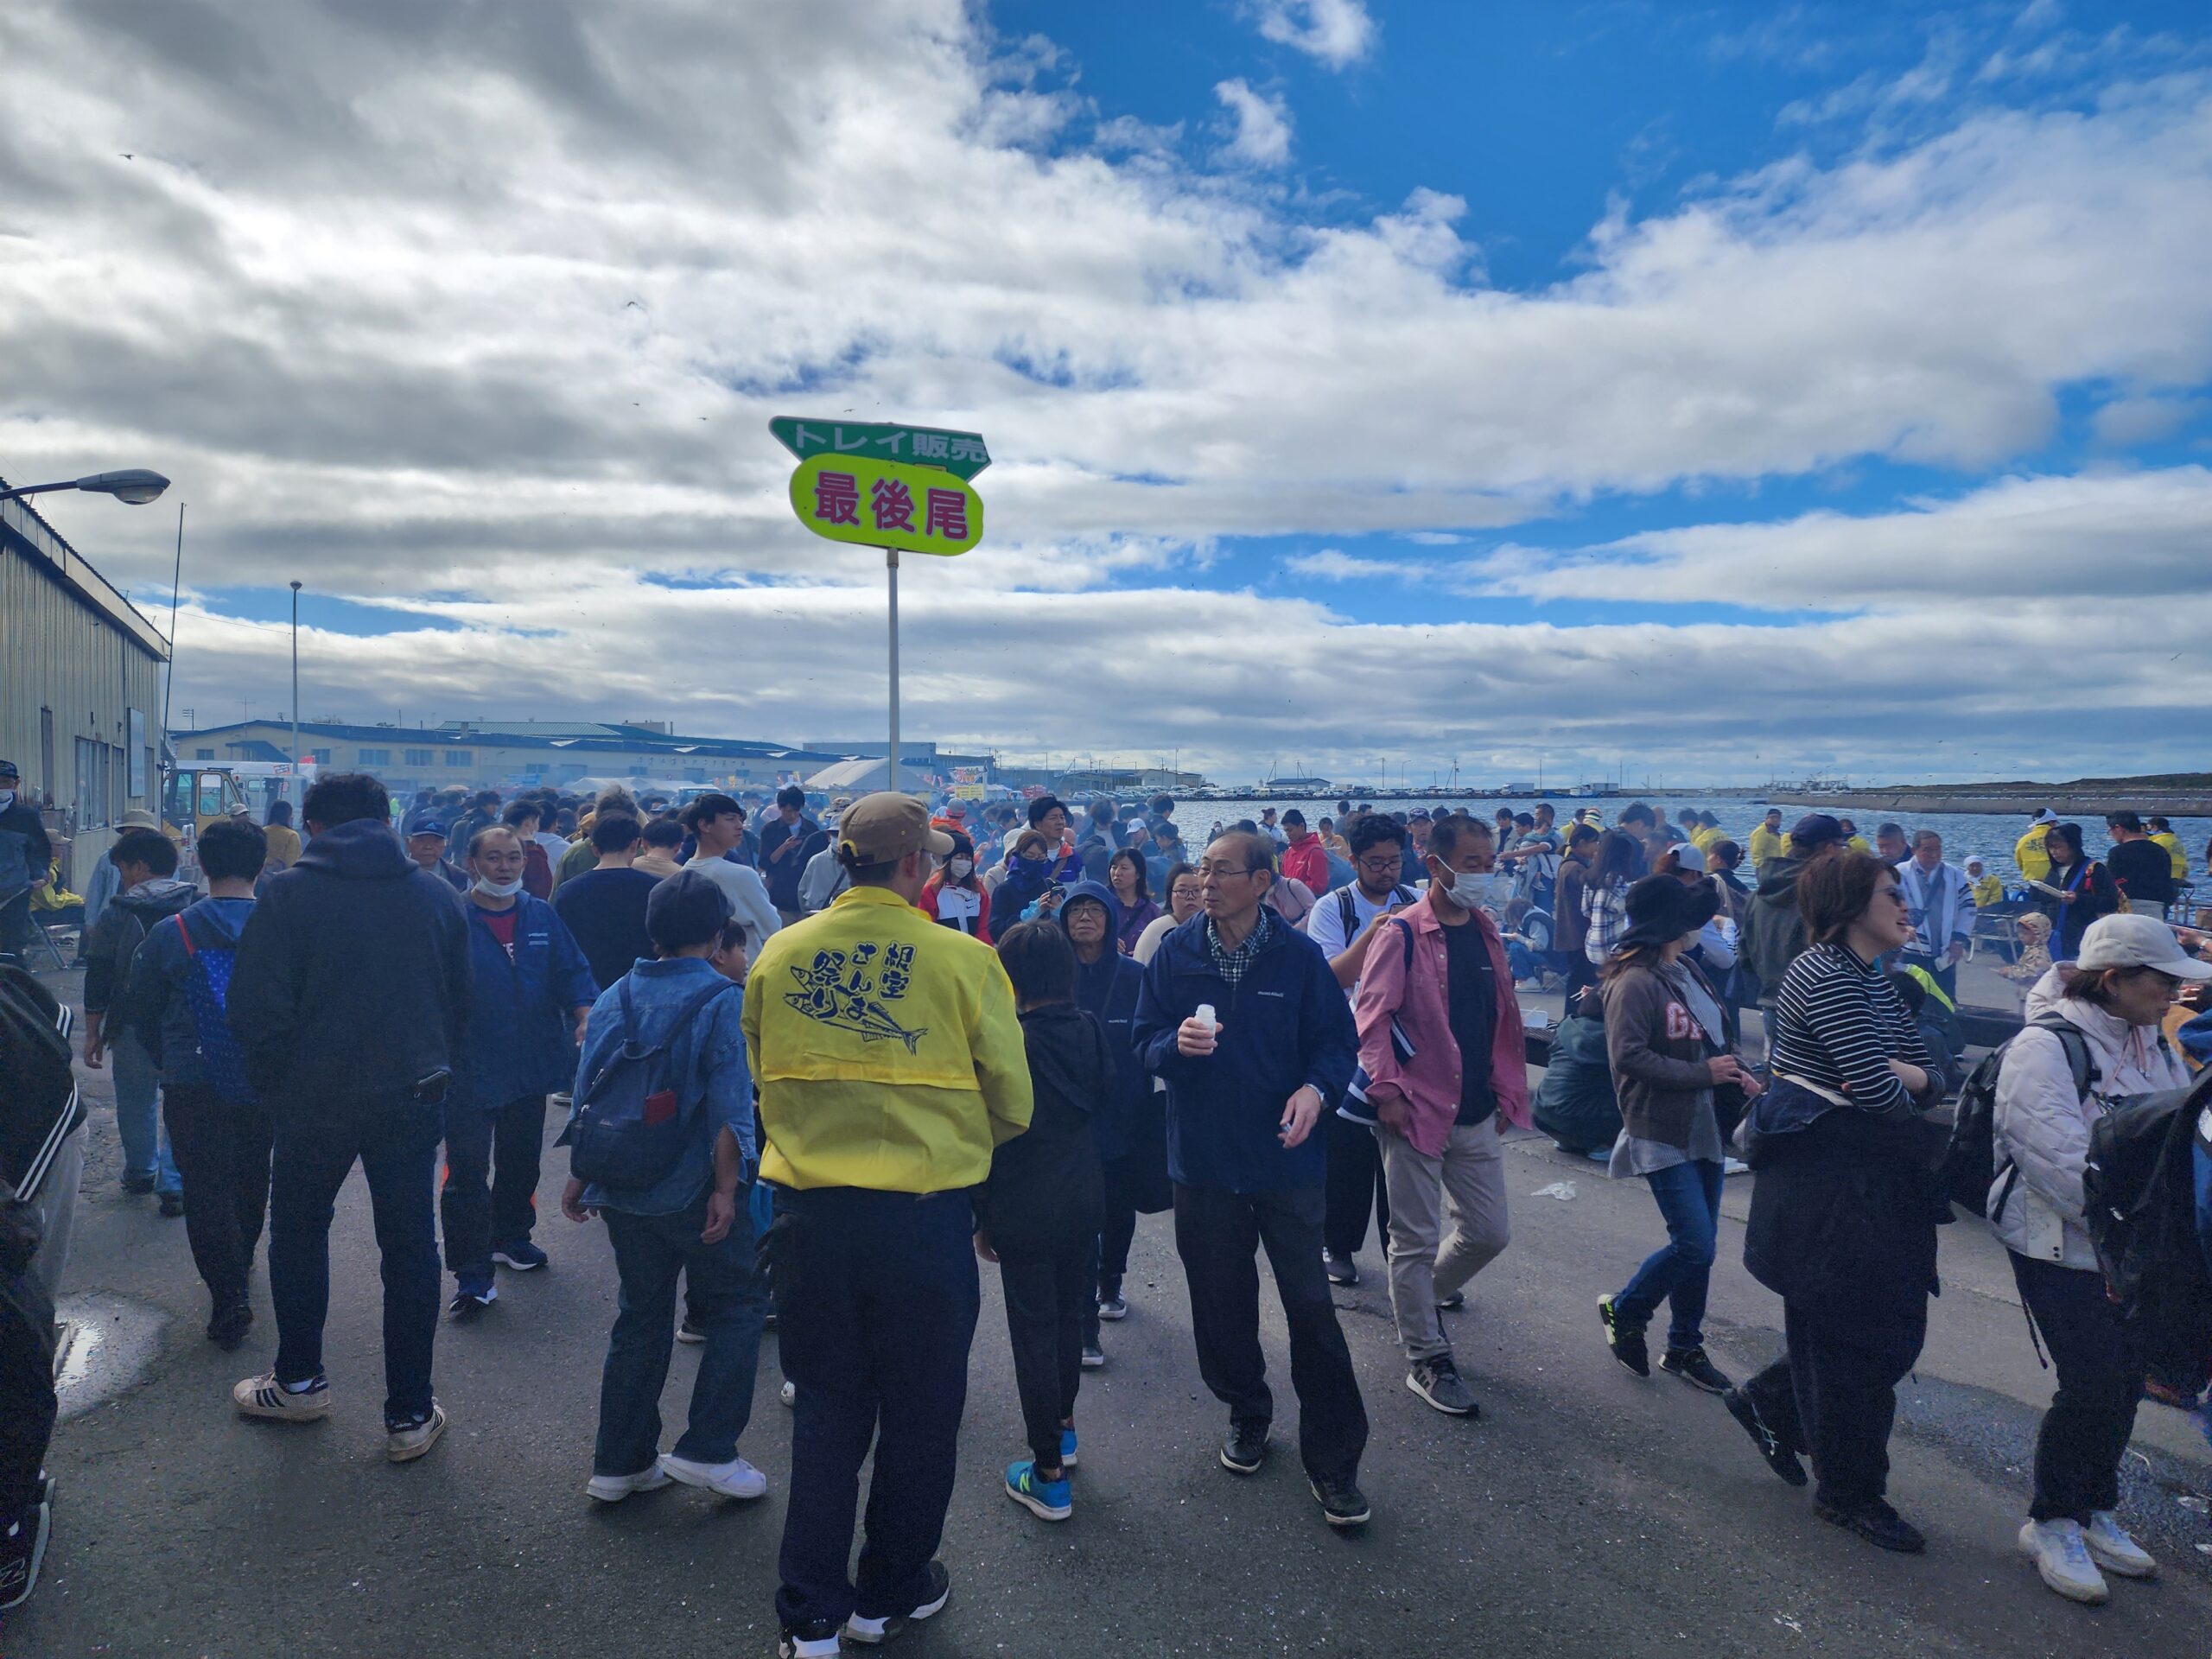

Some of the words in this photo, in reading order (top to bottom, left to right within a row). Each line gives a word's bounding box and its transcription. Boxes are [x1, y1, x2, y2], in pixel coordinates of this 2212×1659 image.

[795, 423, 988, 463] トレイ販売
[813, 471, 969, 540] 最後尾
[811, 950, 846, 1020] 祭り
[845, 943, 878, 1020] さんま
[880, 942, 916, 1000] 根室
